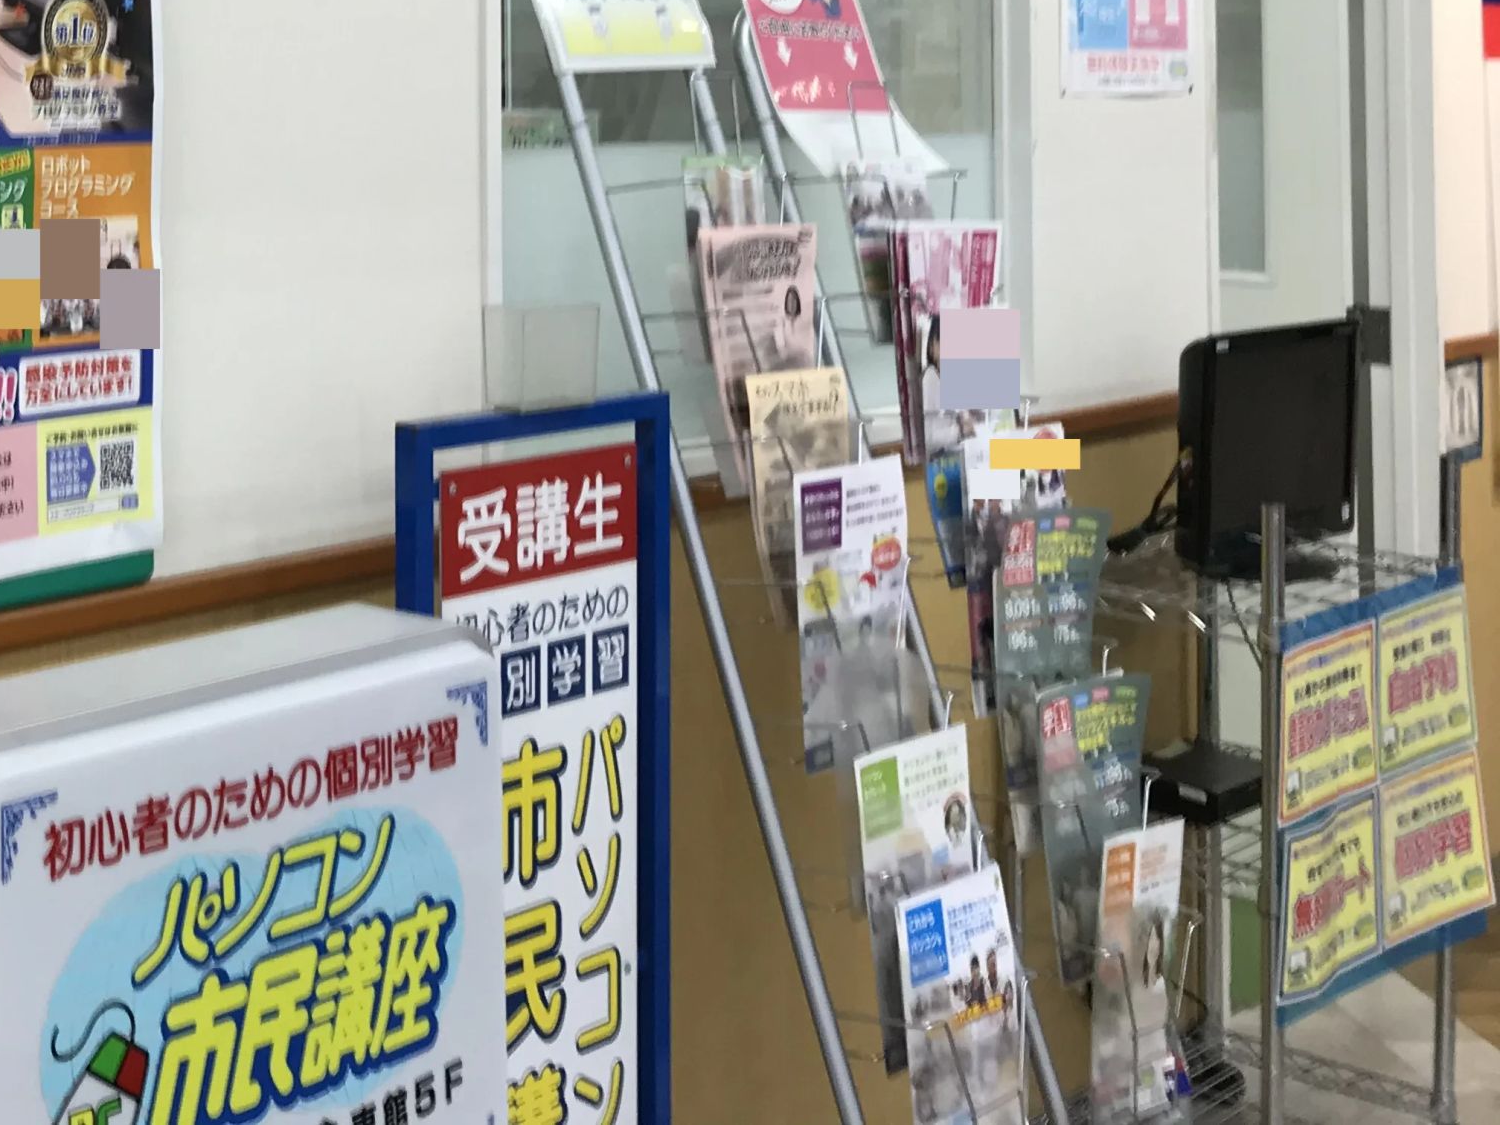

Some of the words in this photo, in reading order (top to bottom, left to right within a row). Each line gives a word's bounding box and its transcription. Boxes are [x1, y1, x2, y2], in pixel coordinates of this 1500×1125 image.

[456, 472, 624, 584] 受講生
[42, 716, 460, 882] 初心者のための個別学習
[133, 812, 396, 989] パソコン
[149, 895, 455, 1125] 市民講座
